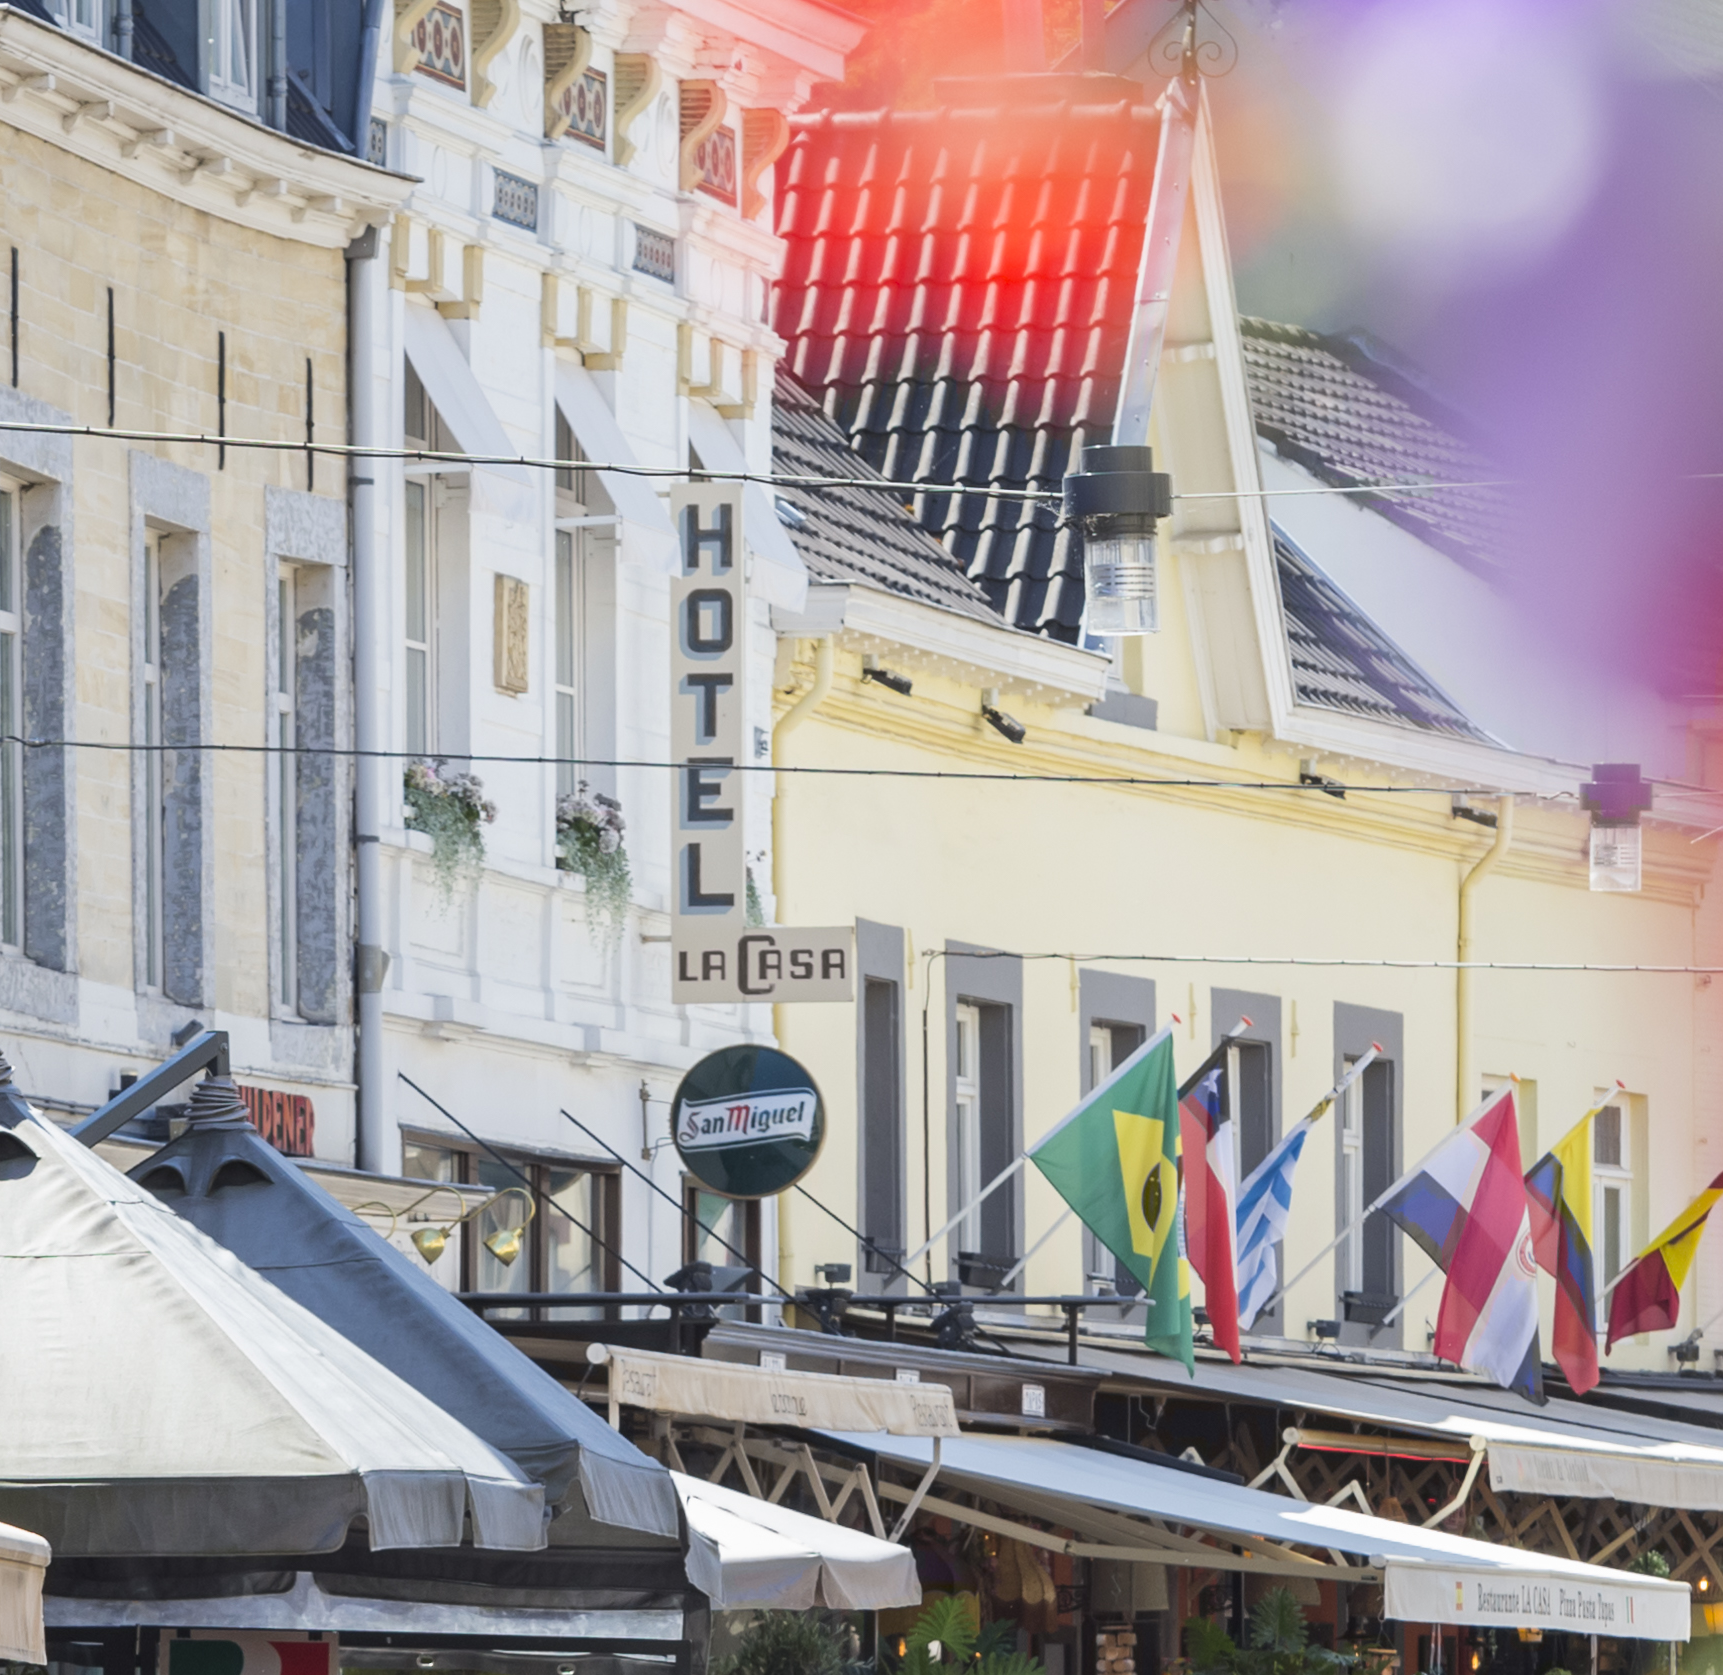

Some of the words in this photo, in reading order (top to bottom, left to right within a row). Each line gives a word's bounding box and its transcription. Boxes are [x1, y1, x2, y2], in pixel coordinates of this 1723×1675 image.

[680, 502, 734, 912] HOTEL
[679, 951, 725, 981] LA
[737, 935, 846, 995] CASA
[1478, 1583, 1519, 1613] Restaurante
[1522, 1585, 1530, 1614] LA
[1533, 1586, 1551, 1616] CASA
[1559, 1588, 1576, 1616] Pizza
[1578, 1591, 1595, 1619] Pasta
[1597, 1593, 1615, 1627] Tapas
